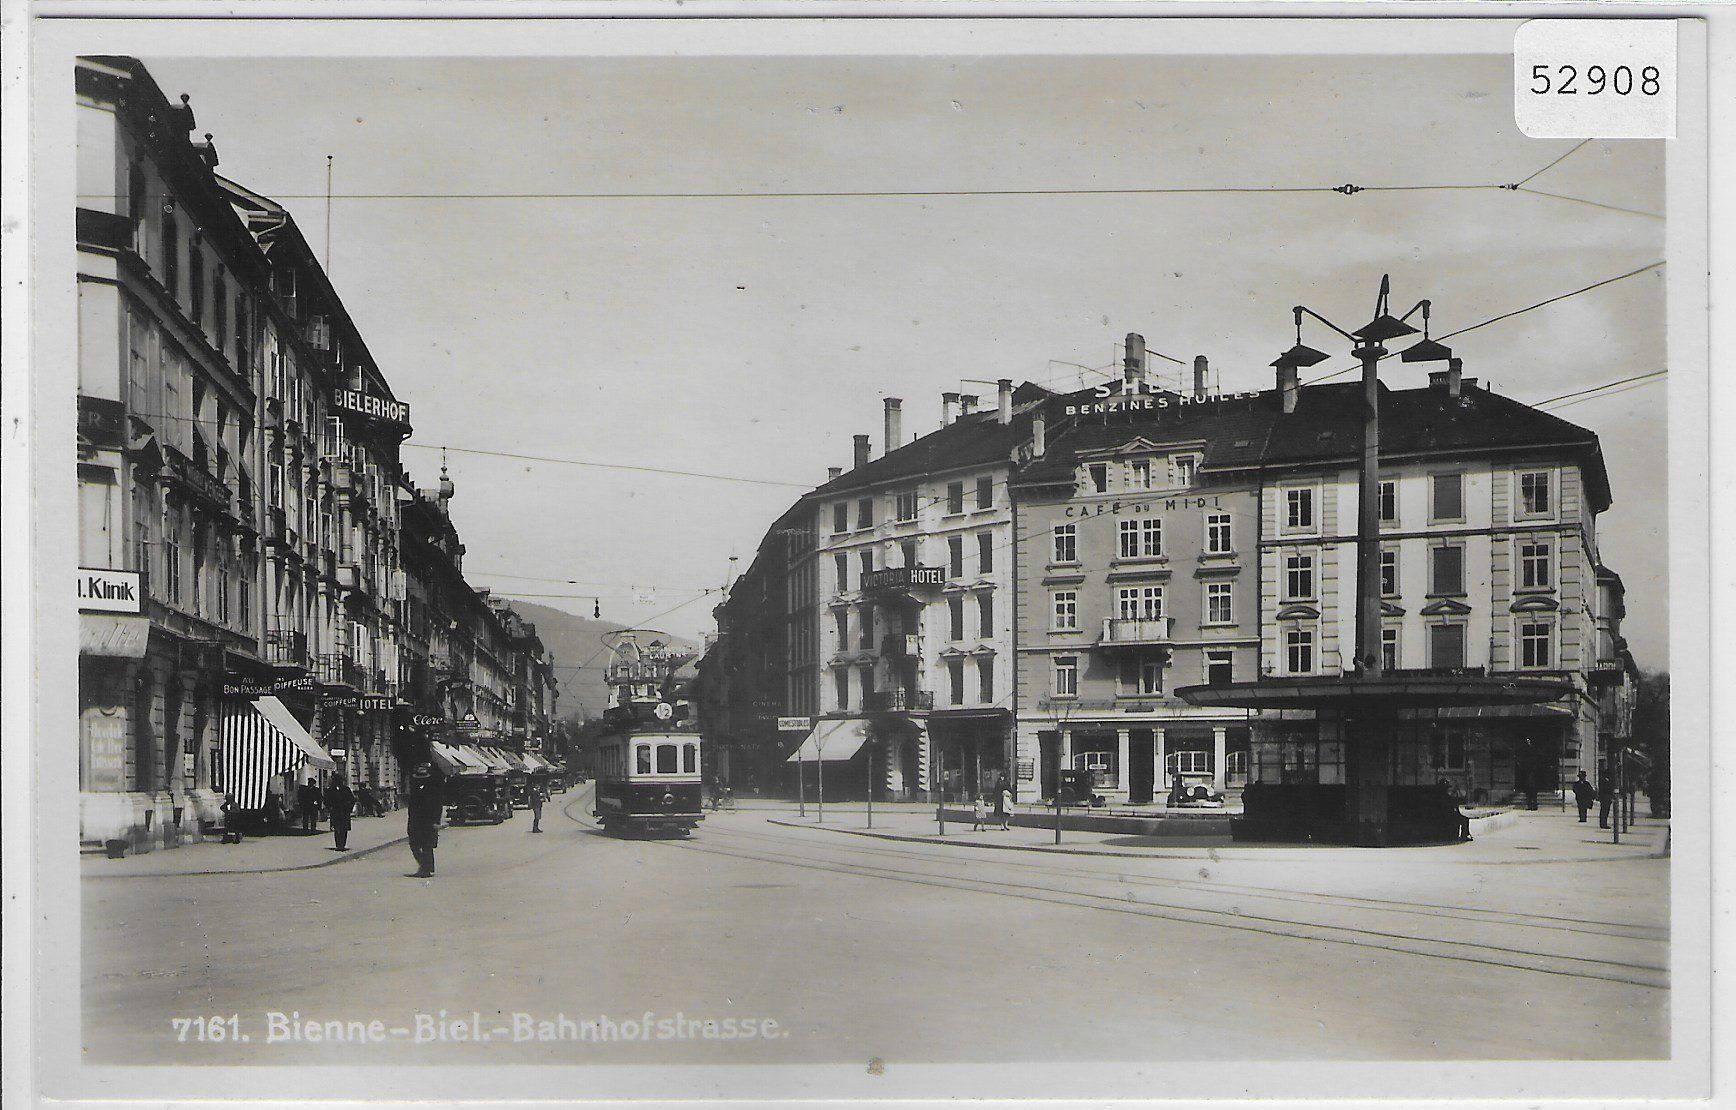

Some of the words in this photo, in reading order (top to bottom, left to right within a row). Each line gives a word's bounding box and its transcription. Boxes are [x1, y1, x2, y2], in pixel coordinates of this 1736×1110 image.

[334, 388, 407, 422] BIELERHOF
[1065, 397, 1169, 415] BENZINES
[1180, 390, 1260, 406] HUILES
[1135, 504, 1150, 513] DU
[1165, 496, 1220, 511] MIDI
[863, 571, 906, 588] VICTORIA
[910, 569, 944, 585] HOTEL
[88, 577, 135, 601] Klinik
[241, 677, 253, 685] AU
[273, 678, 314, 691] OIFFEUSE
[223, 684, 239, 695] BON
[240, 685, 273, 696] PASSAGE
[323, 697, 357, 708] COIFFEUR
